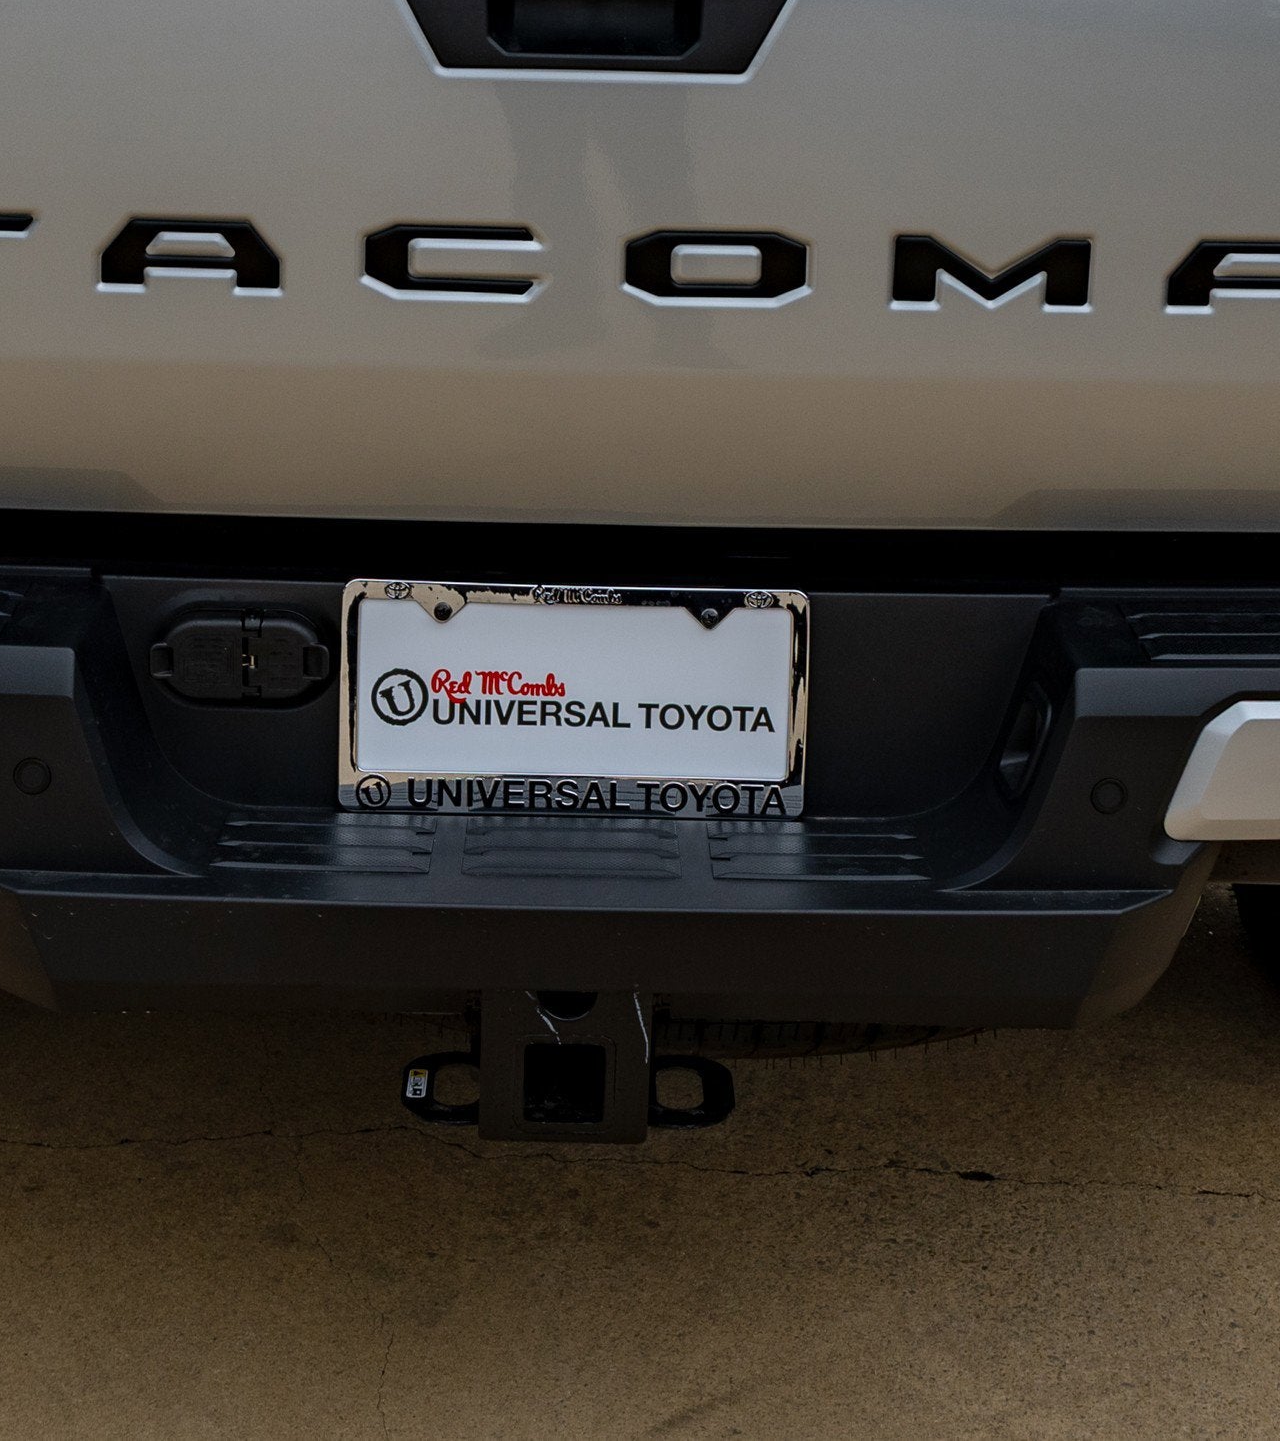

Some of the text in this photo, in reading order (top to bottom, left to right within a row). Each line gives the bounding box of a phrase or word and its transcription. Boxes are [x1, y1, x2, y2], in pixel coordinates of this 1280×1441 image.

[431, 669, 566, 704] Red McCombs
[431, 699, 776, 732] UNIVERSAL TOYOTA
[407, 776, 631, 811] UNIVERSAL
[636, 781, 787, 815] TOYOTA
